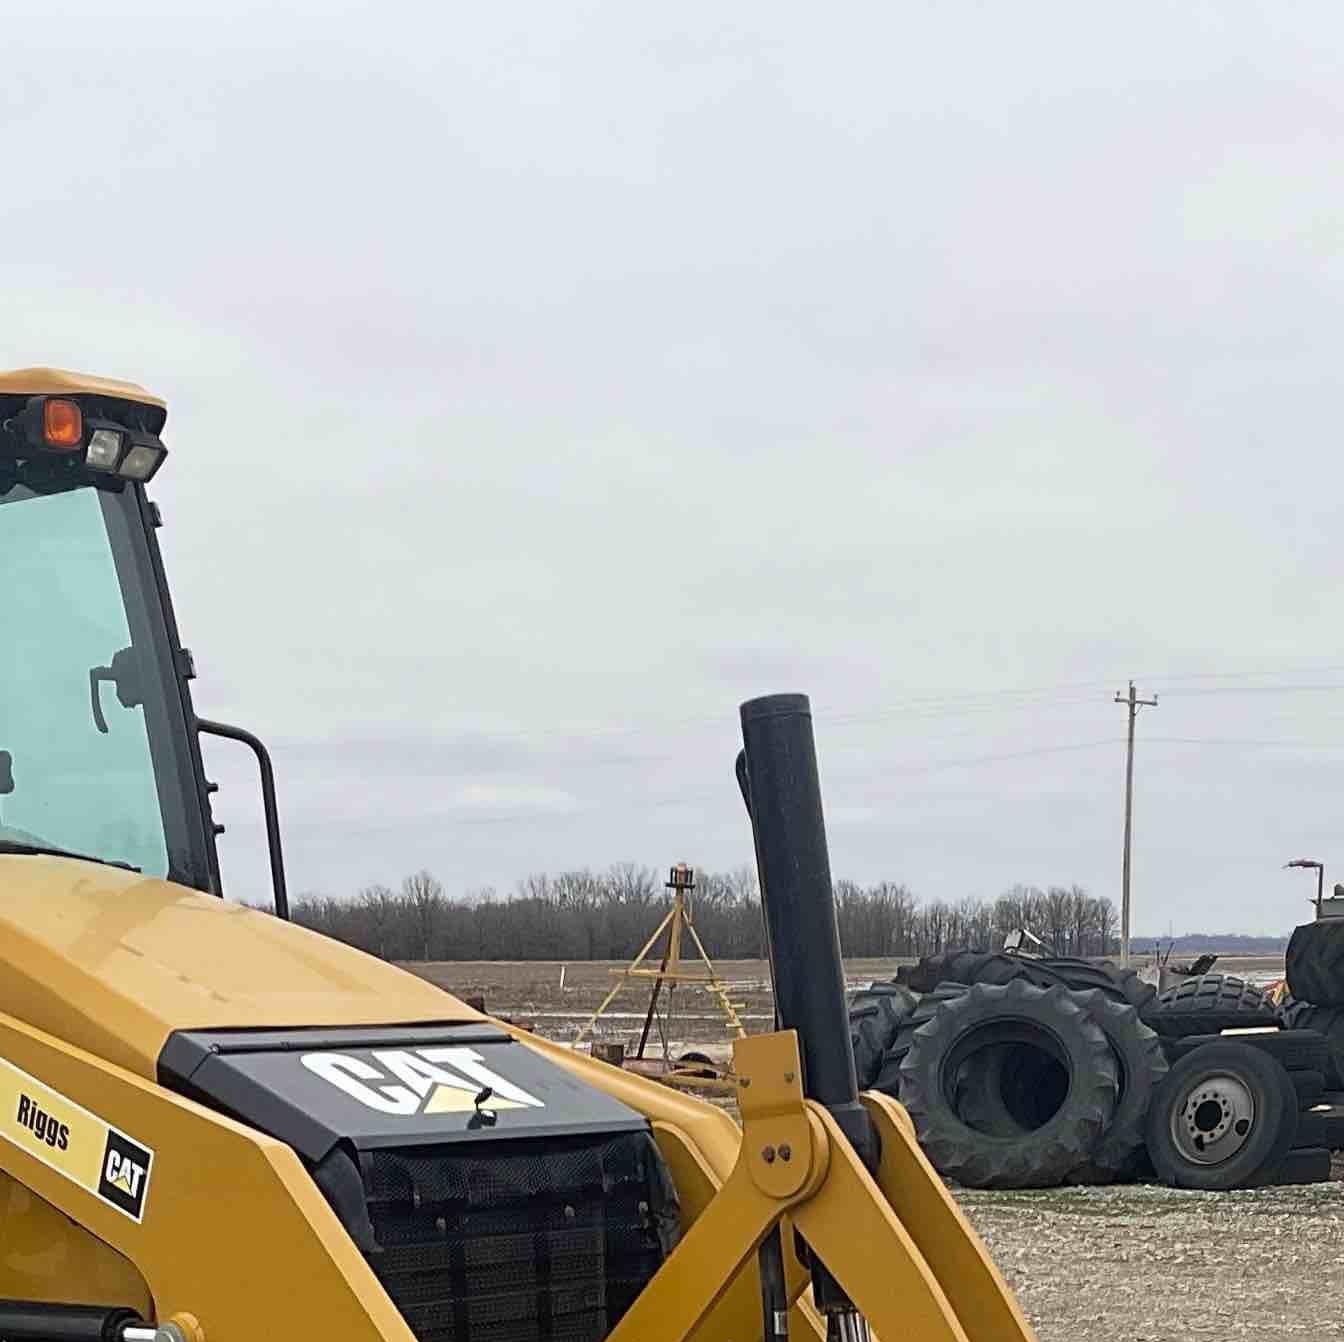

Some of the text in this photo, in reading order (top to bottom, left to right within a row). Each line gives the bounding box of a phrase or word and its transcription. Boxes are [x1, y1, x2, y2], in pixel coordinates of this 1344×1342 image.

[300, 1047, 545, 1115] CAT
[17, 1093, 70, 1151] Riggs
[105, 1149, 147, 1199] CAT
